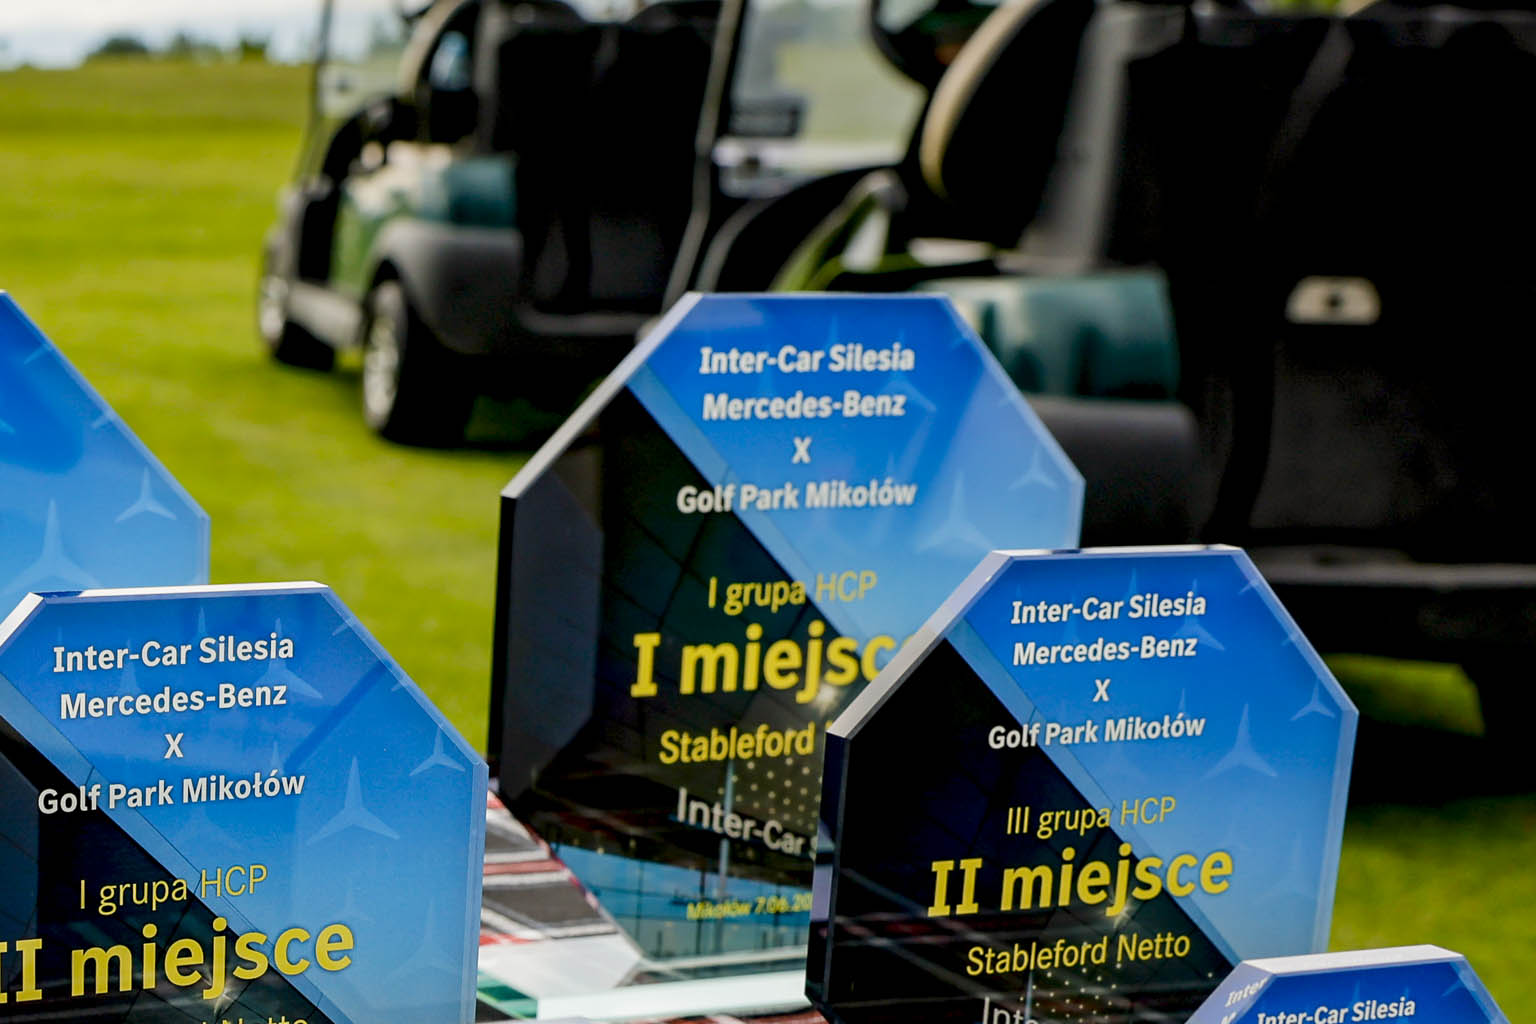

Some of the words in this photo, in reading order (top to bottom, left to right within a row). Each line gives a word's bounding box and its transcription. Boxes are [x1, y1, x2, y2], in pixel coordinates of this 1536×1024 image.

[699, 345, 824, 374] Inter-Car
[828, 342, 915, 372] Silesia
[702, 390, 907, 420] Mercedes-Benz
[676, 483, 737, 513] Golf
[740, 482, 799, 511] Park
[805, 477, 918, 508] Mikołów
[708, 576, 718, 608] I
[723, 580, 806, 616] grupa
[816, 570, 877, 602] HCP
[1011, 597, 1124, 625] Inter-Car
[1128, 591, 1206, 619] Silesia
[53, 640, 192, 673] Inter-Car
[199, 632, 294, 664] Silesia
[630, 632, 661, 697] I
[679, 619, 914, 704] miejsc
[1013, 636, 1198, 666] Mercedes-Benz
[60, 683, 287, 720] Mercedes-Benz
[659, 720, 815, 764] Stableford
[988, 722, 1040, 749] Golf
[1044, 719, 1099, 746] Park
[1104, 712, 1206, 743] Mikołów
[38, 784, 101, 815] Golf
[109, 780, 174, 810] Park
[182, 769, 306, 803] Mikołów
[676, 787, 806, 855] Inter-Car
[1006, 806, 1030, 835] III
[1036, 807, 1112, 840] grupa
[1120, 796, 1176, 826] HCP
[80, 879, 86, 909] I
[98, 878, 188, 916] grupa
[201, 864, 267, 898] HCP
[928, 858, 983, 917] II
[1000, 842, 1233, 917] miejsce
[71, 916, 355, 1000] miejsce
[966, 936, 1107, 976] Stableford
[1117, 932, 1190, 962] Netto
[1351, 997, 1415, 1022] Silesia
